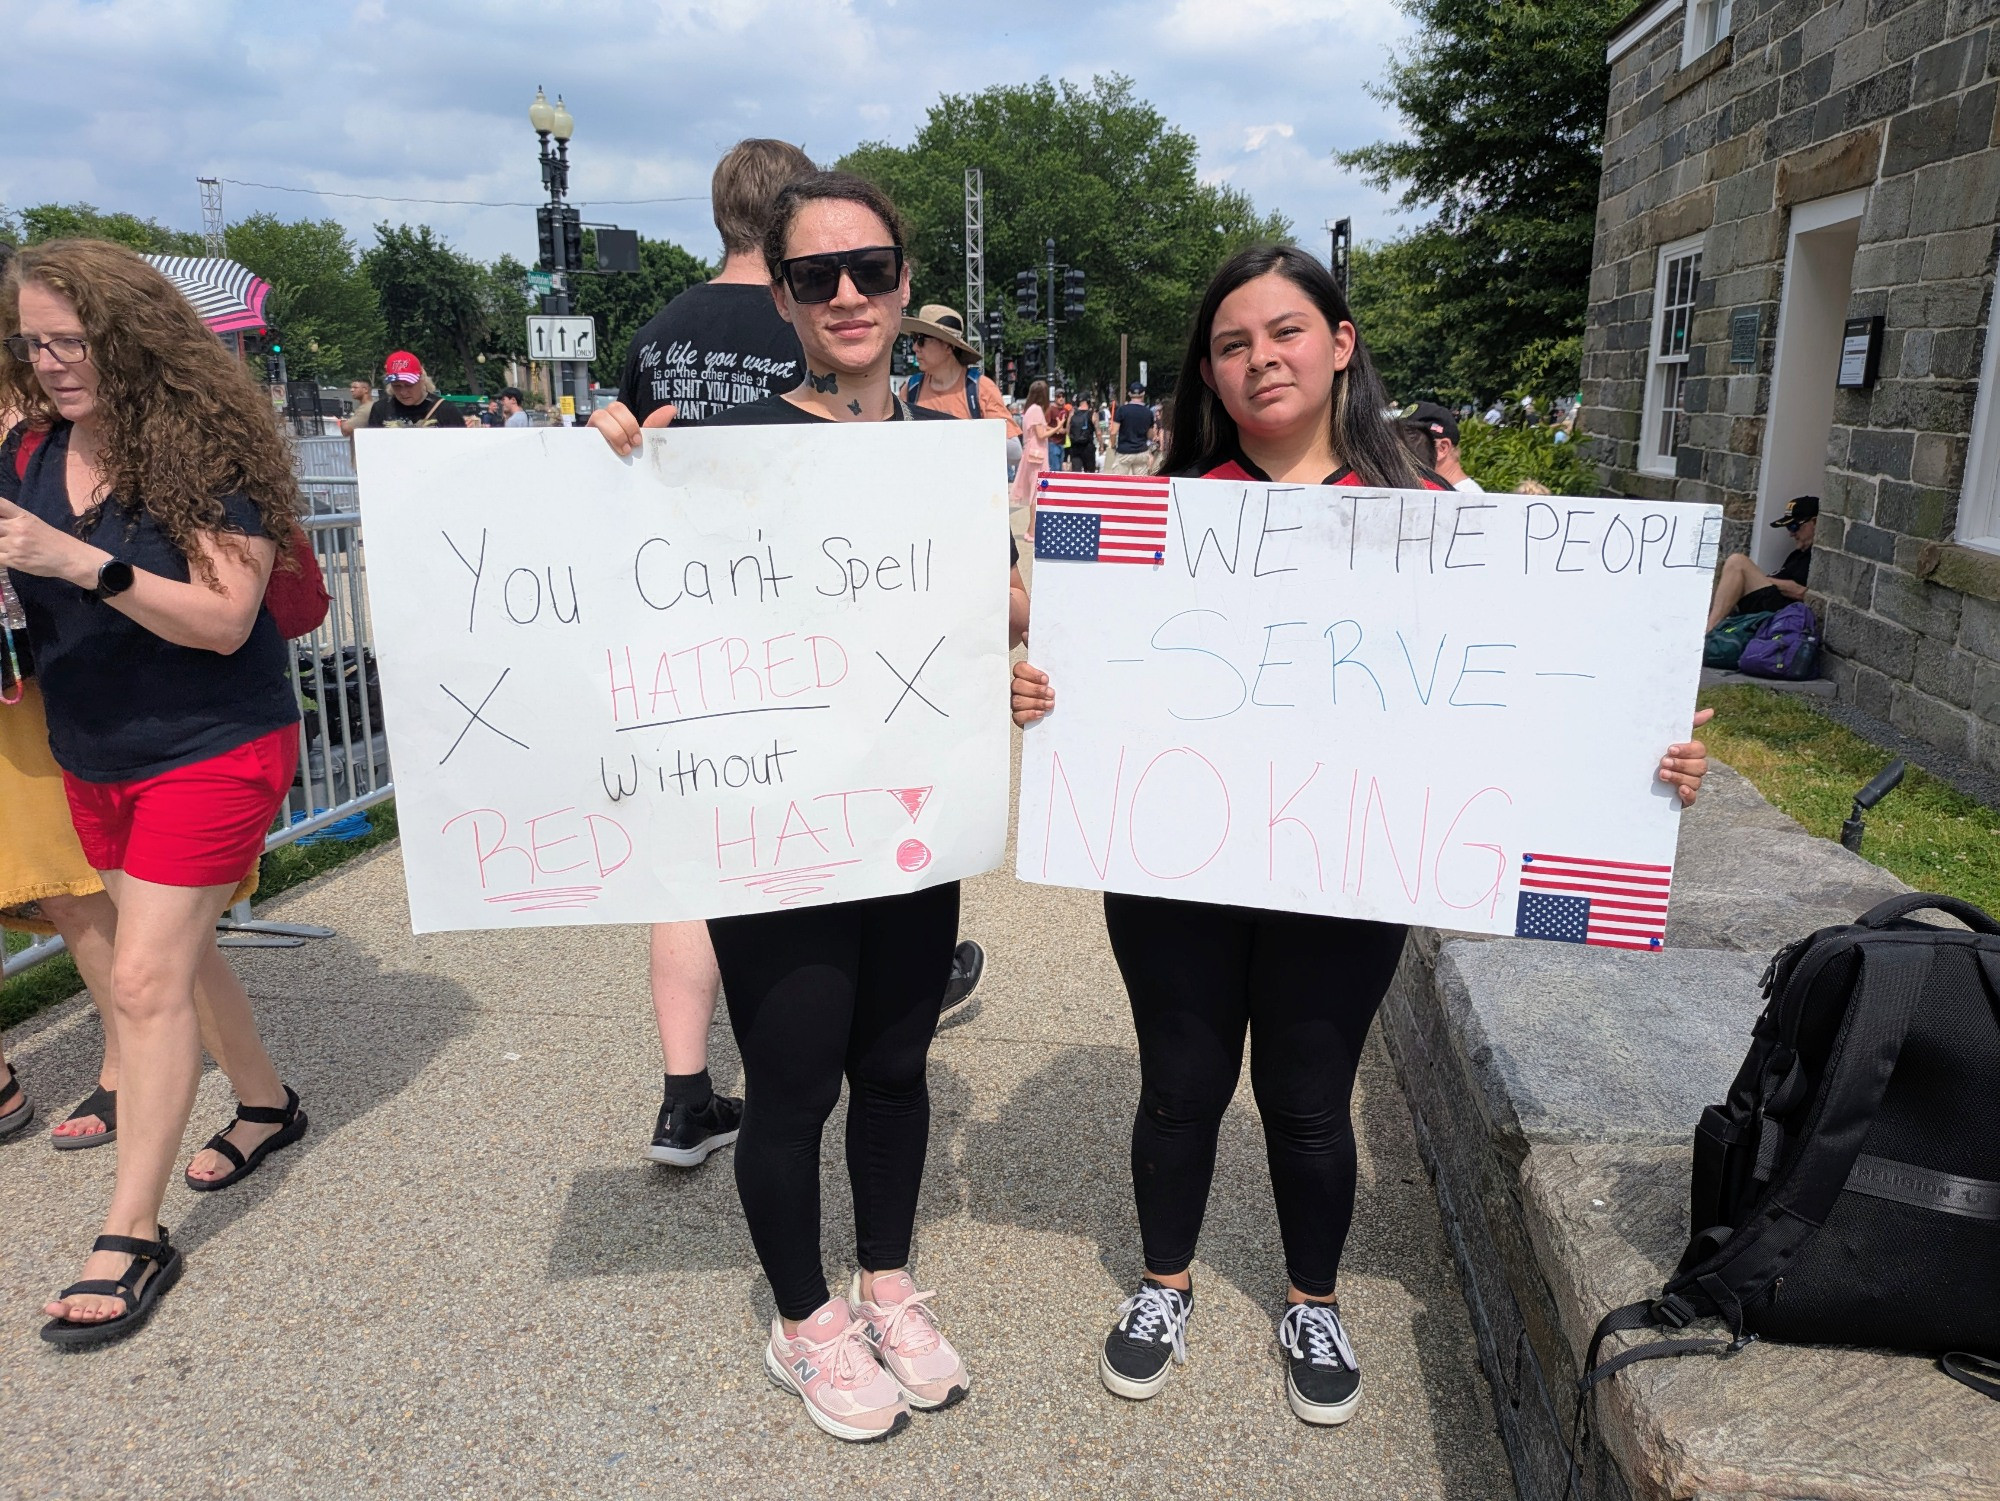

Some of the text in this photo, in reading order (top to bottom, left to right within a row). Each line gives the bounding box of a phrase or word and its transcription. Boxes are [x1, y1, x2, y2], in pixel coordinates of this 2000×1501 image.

[576, 349, 593, 357] ONLY
[639, 340, 797, 379] The life you want
[653, 366, 768, 388] is on the other side of
[651, 379, 772, 404] THE SHIT YOU DON'T
[671, 400, 708, 420] WANT
[1171, 482, 1723, 579] WE THE PEOPLE
[441, 527, 933, 633] You Can't Spell
[606, 632, 849, 721] HATRED
[600, 739, 798, 802] Without
[441, 784, 934, 889] RED HAT!
[1043, 745, 1513, 919] NO KING
[792, 1356, 820, 1385] N
